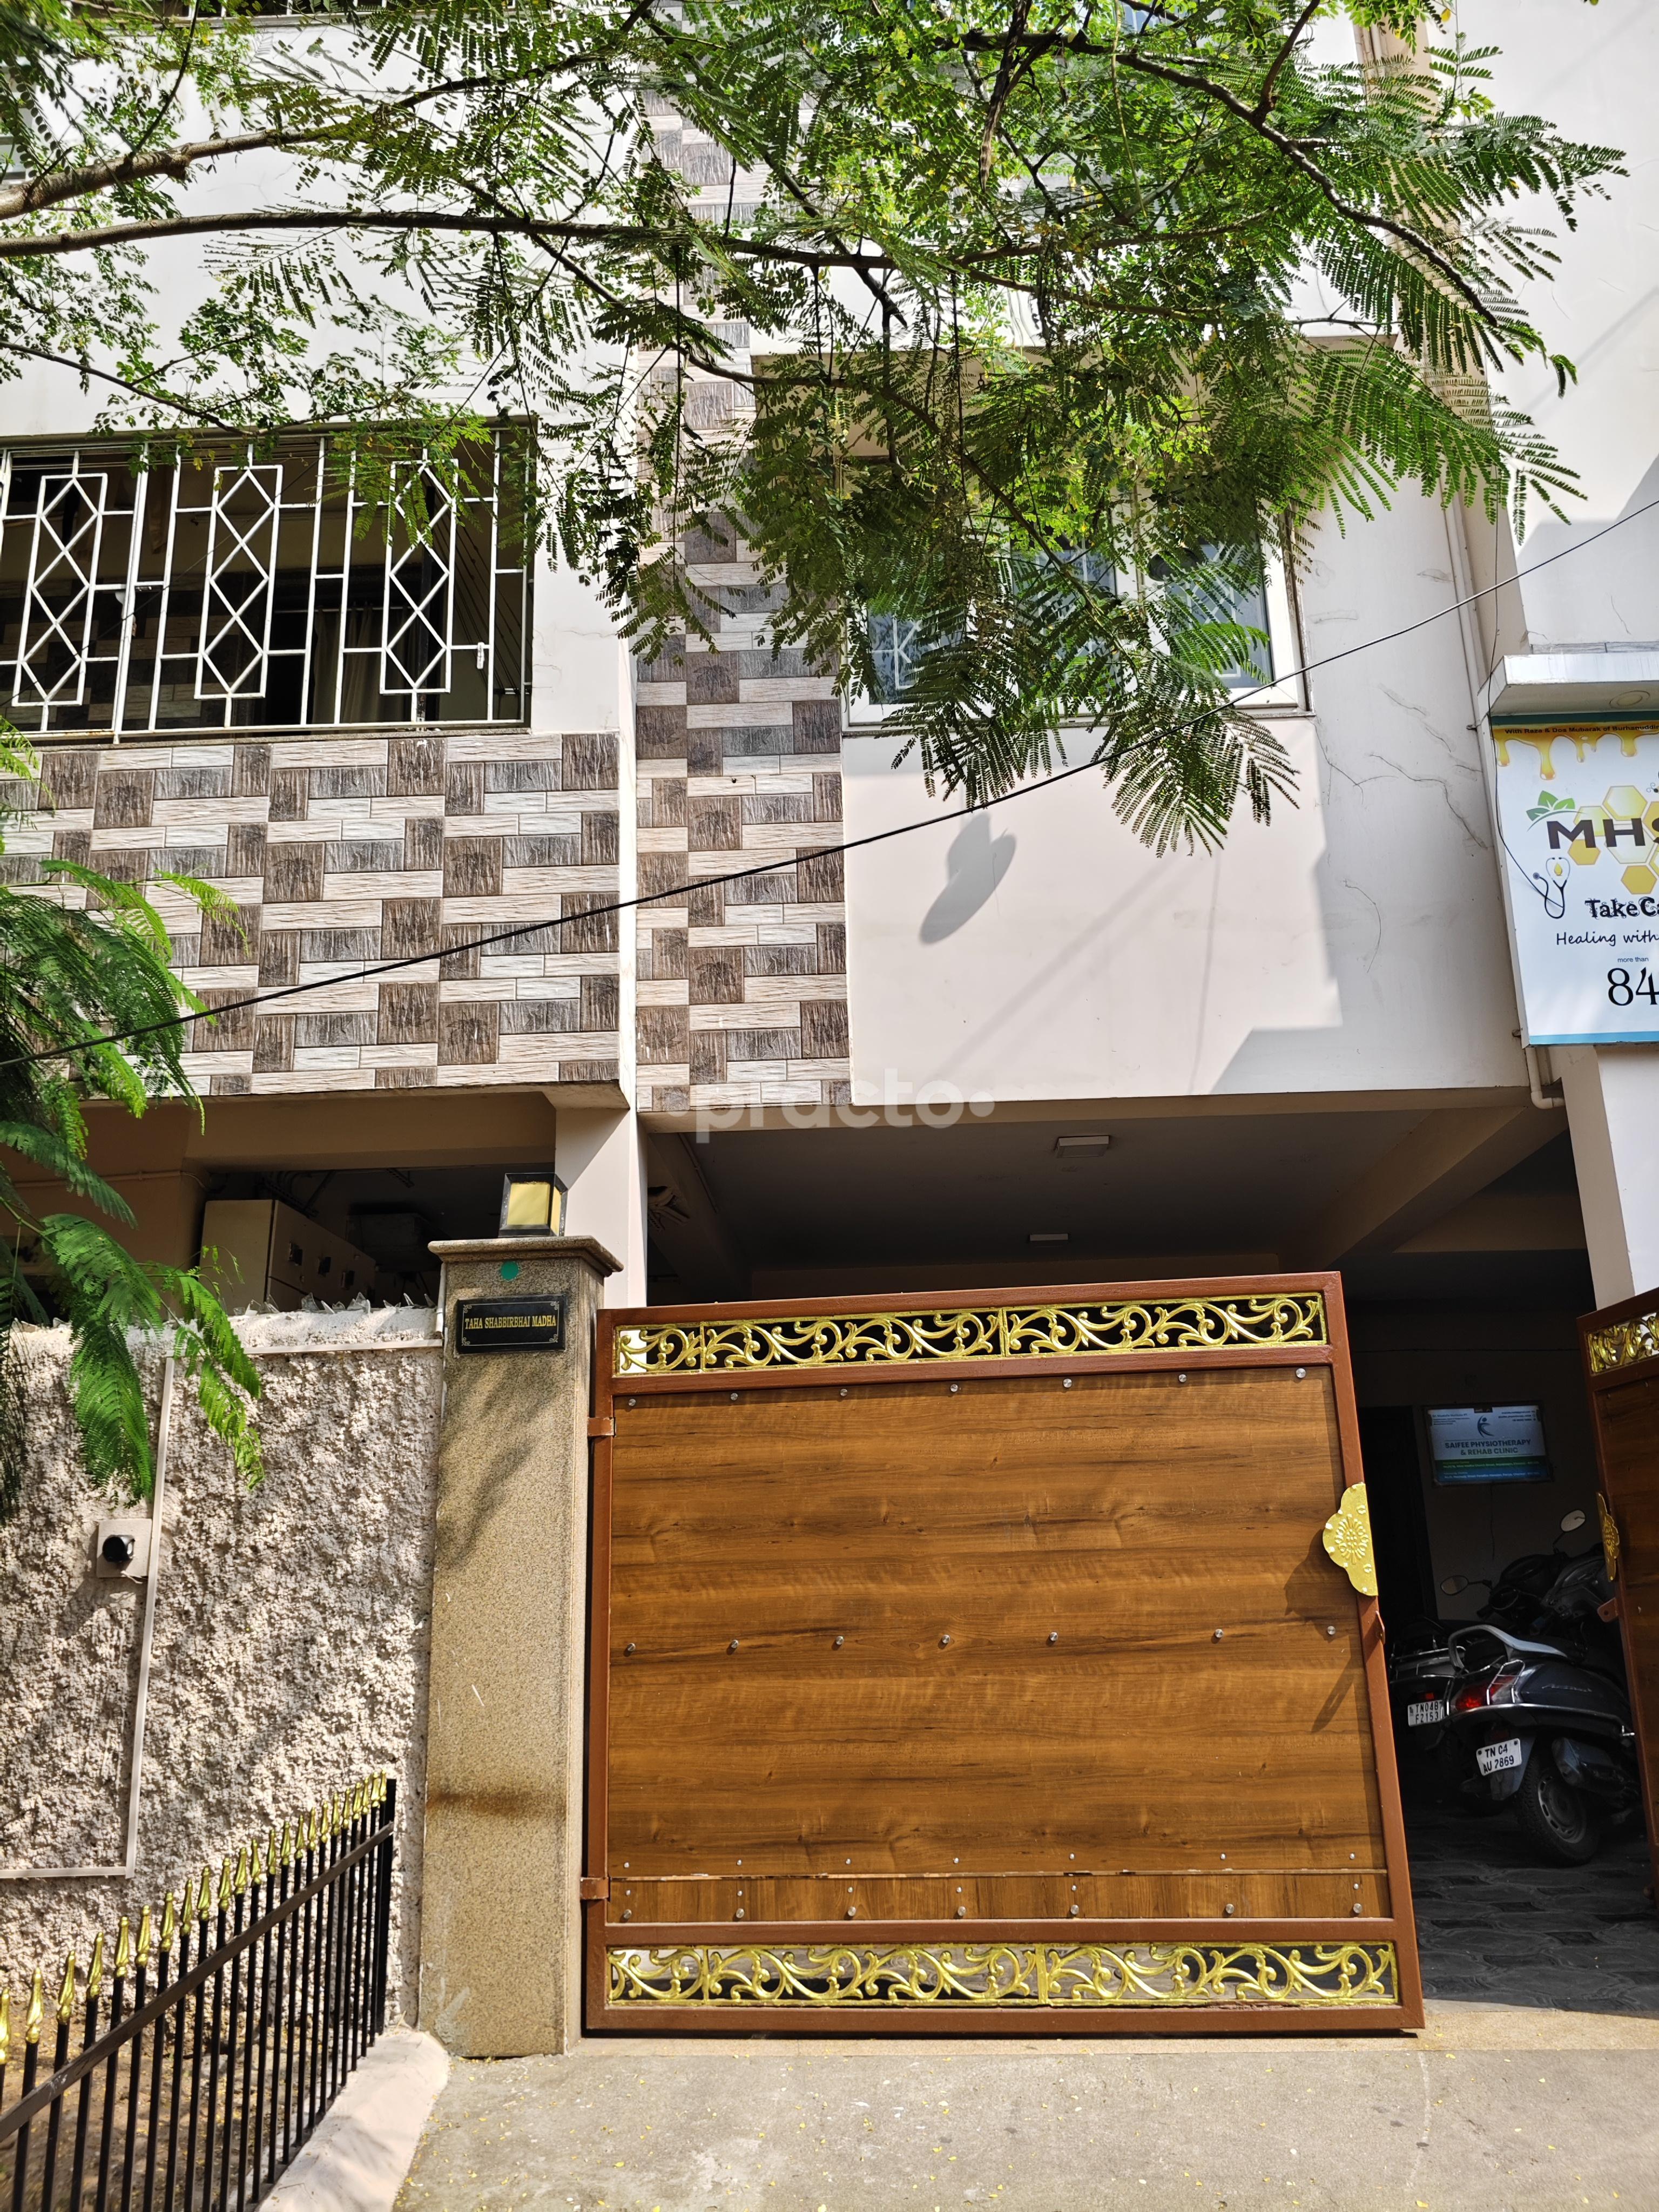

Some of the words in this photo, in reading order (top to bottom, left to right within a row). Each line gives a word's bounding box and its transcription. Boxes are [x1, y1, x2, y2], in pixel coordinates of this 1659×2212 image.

[1547, 818, 1659, 849] MH
[1584, 896, 1659, 919] TakeC
[1556, 932, 1616, 946] Healing
[1623, 930, 1659, 943] with
[1607, 967, 1659, 1006] 84
[465, 1318, 483, 1329] TAHA
[484, 1316, 530, 1328] SHABBIRBHAI
[532, 1315, 556, 1326] MADHA
[1471, 1439, 1531, 1448] PHYSIOTHERAPY
[1485, 1748, 1495, 1757] TN
[1483, 1763, 1492, 1773] AU
